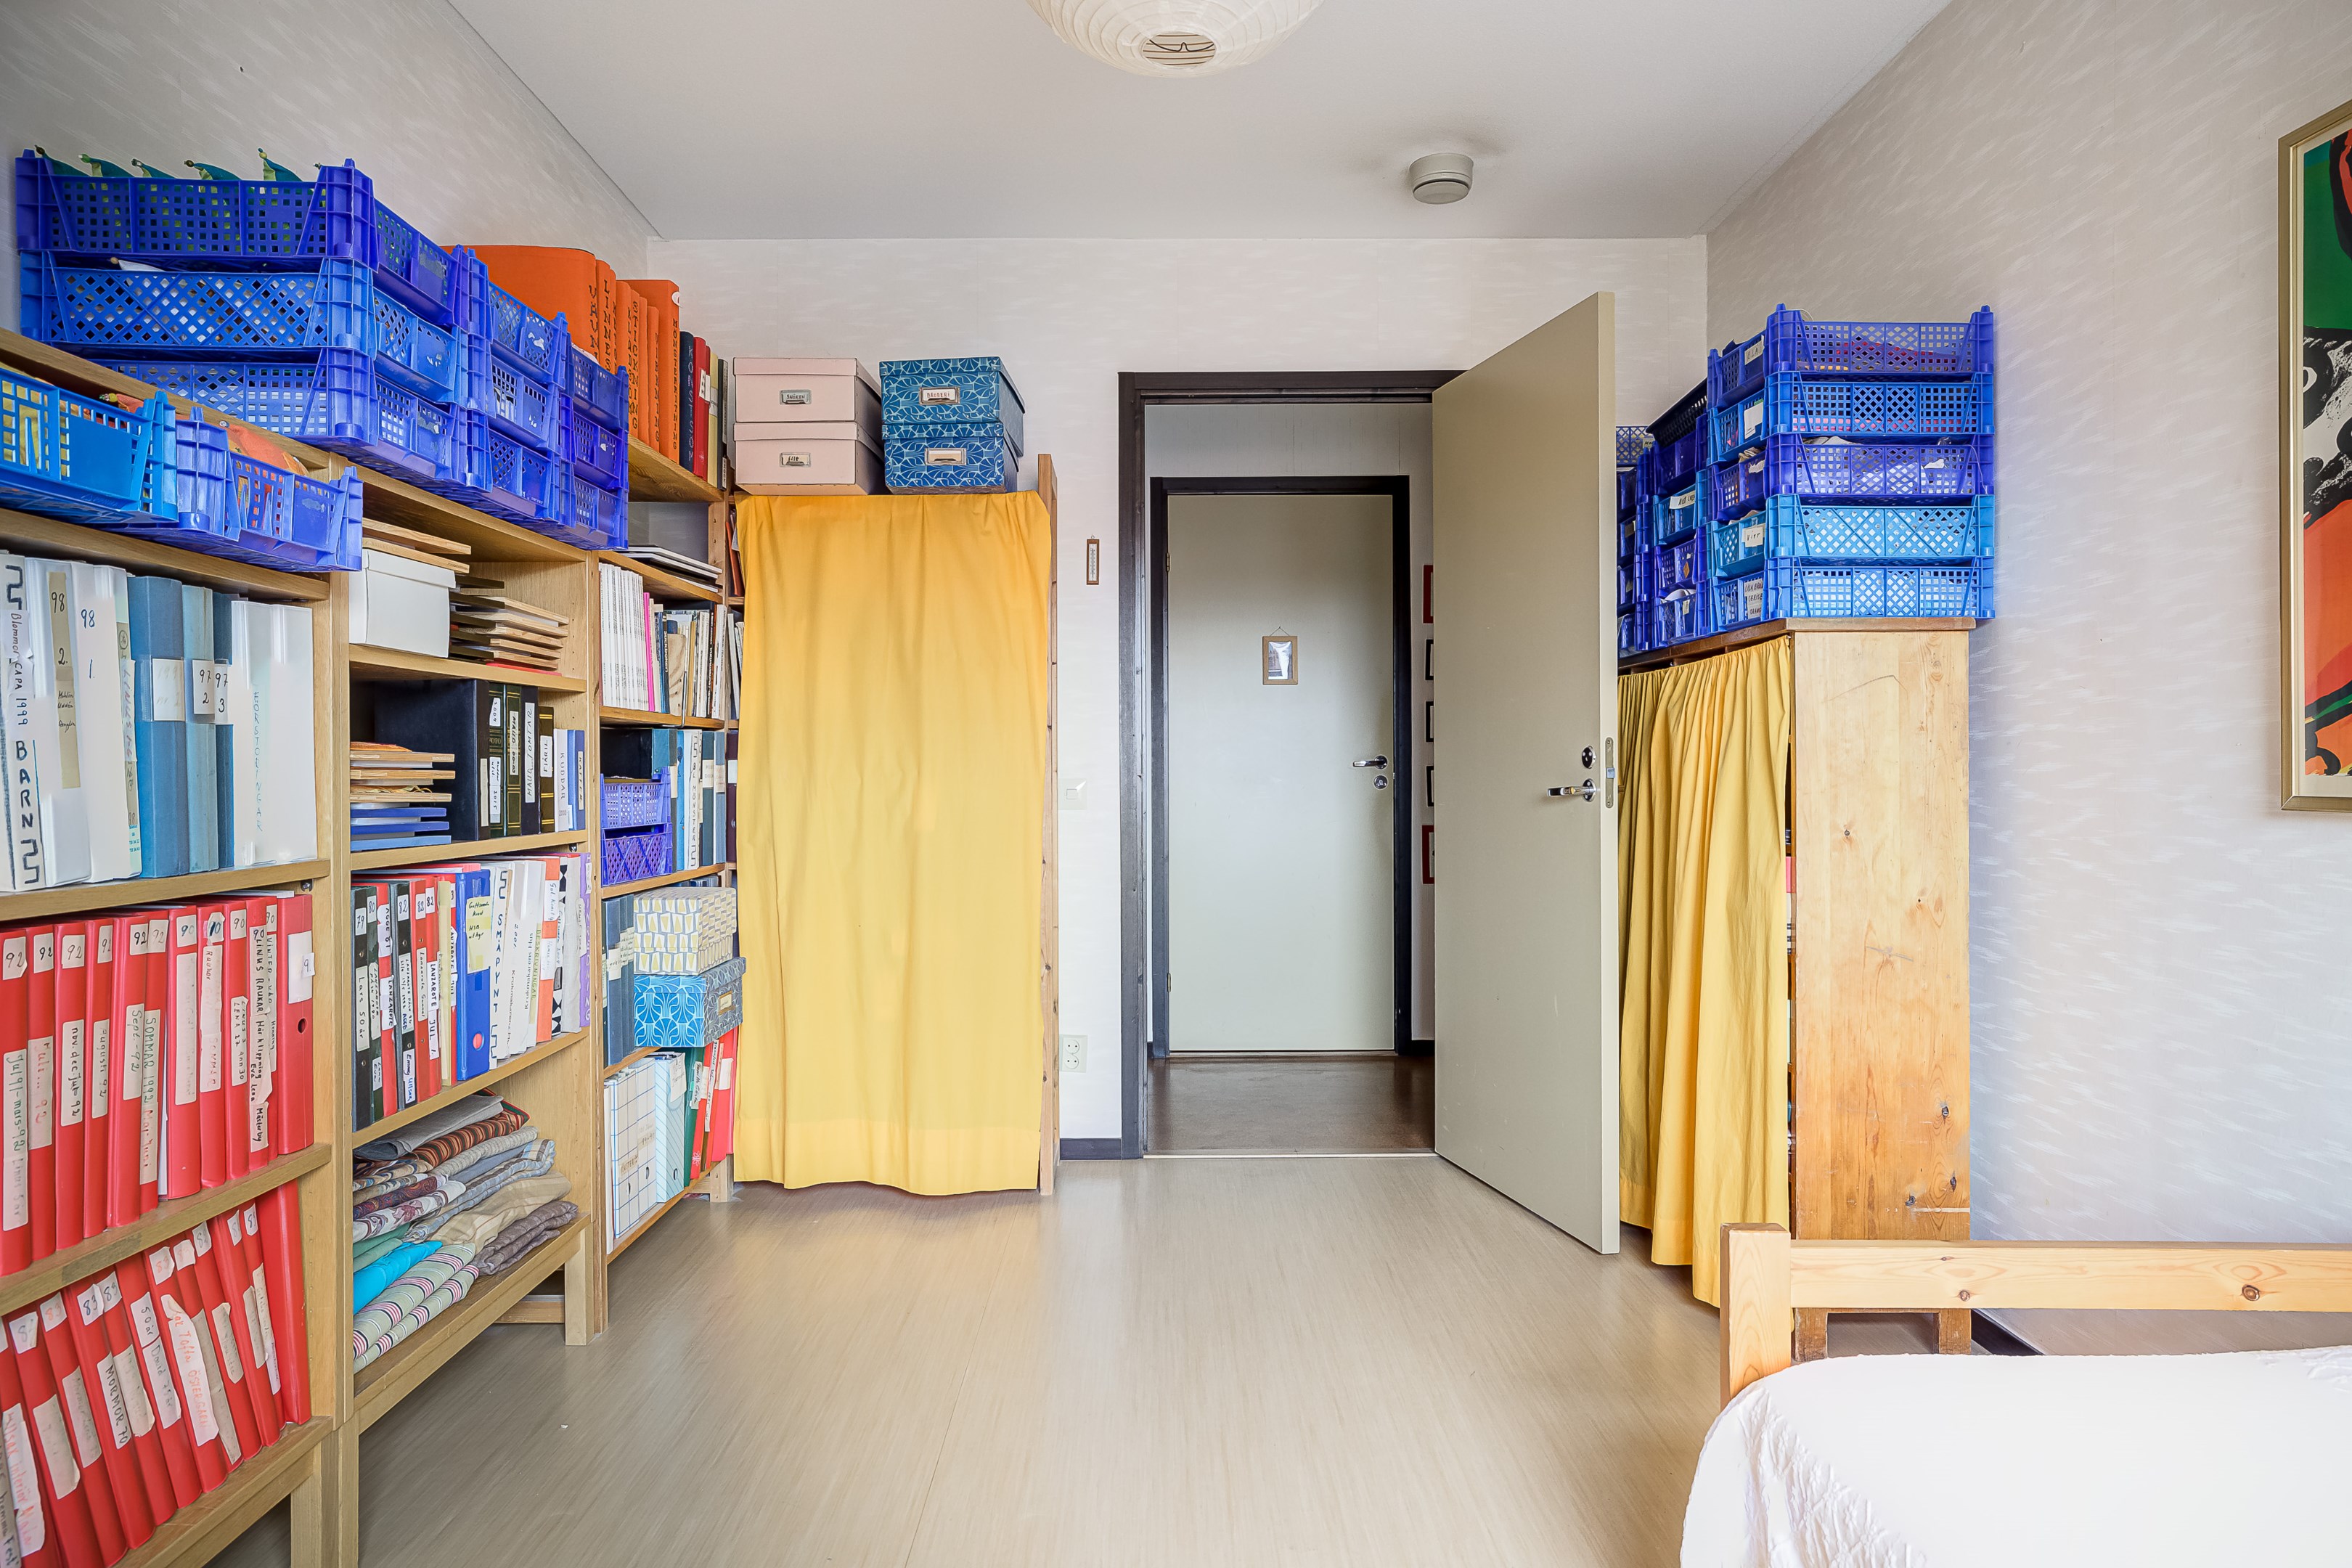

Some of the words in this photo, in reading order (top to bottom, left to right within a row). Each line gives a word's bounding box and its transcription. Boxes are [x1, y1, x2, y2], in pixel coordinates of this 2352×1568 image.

[51, 592, 65, 613] 98
[81, 609, 95, 628] 98
[200, 669, 212, 683] 97
[215, 672, 229, 687] 97
[203, 692, 210, 704] 2
[218, 698, 225, 713] 3
[16, 698, 28, 725] 1999
[16, 740, 33, 828] BARN
[399, 899, 408, 915] 82
[427, 897, 434, 907] 82
[234, 918, 245, 930] 90
[356, 914, 365, 929] 79
[134, 932, 147, 944] 92
[152, 929, 164, 944] 92
[181, 925, 195, 936] 90
[253, 928, 264, 940] 90
[5, 952, 25, 968] 92
[39, 947, 53, 960] 92
[68, 944, 83, 960] 92
[254, 937, 264, 972] LINUS
[255, 977, 265, 1013] RAUKAR
[359, 1011, 366, 1027] 50
[144, 1017, 157, 1069] SOMMAR
[99, 1079, 107, 1098] 92
[143, 1074, 155, 1103] 1992
[35, 1098, 48, 1124] 92
[70, 1100, 81, 1116] 92
[83, 1294, 98, 1315] 83
[140, 1306, 152, 1324] 50
[105, 1364, 124, 1426] MORMOR
[117, 1426, 128, 1444] 70
